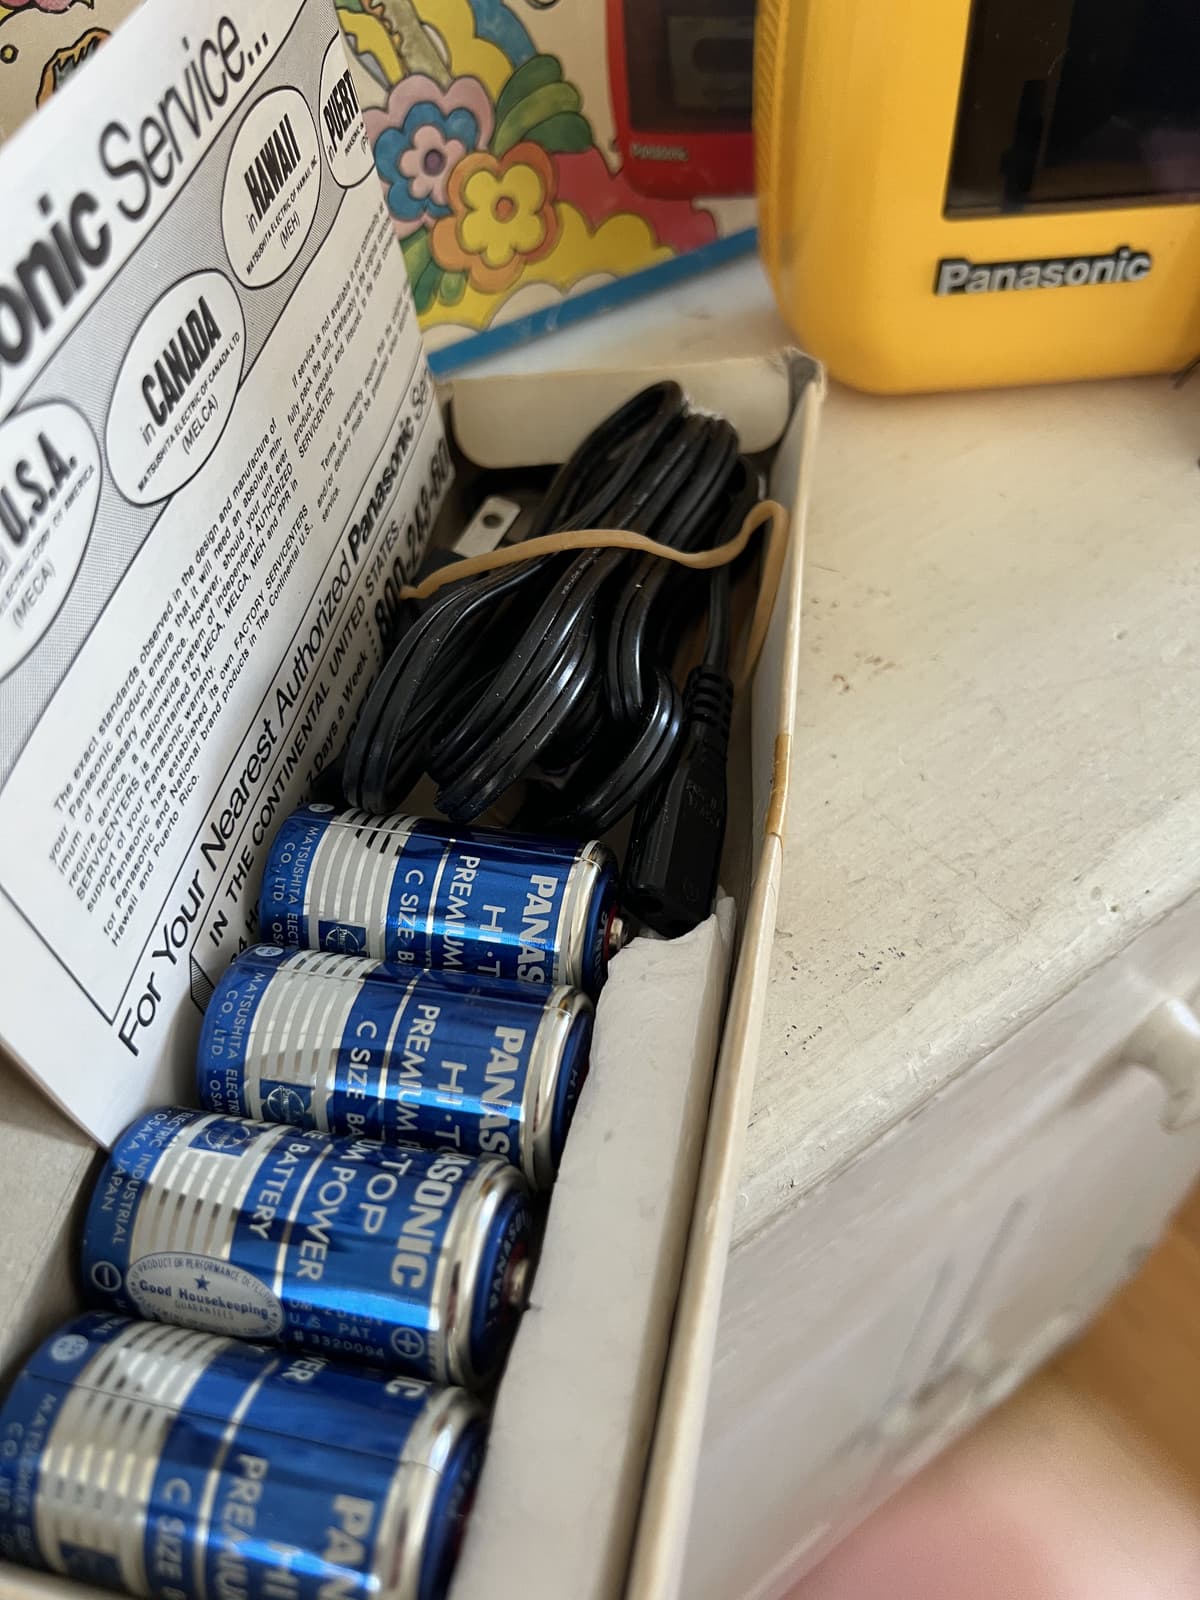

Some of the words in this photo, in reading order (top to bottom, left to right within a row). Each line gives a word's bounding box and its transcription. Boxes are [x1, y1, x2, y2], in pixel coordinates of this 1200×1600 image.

[99, 16, 268, 220] Service...
[244, 113, 301, 222] HAWAII
[246, 213, 258, 234] in
[280, 211, 300, 249] (MEH)
[934, 244, 1153, 297] Panasonic
[142, 296, 221, 426] CANADA
[140, 423, 155, 446] in
[182, 394, 218, 455] (MELCA)
[54, 784, 73, 810] The
[74, 736, 98, 779] exact
[99, 666, 139, 736] standards
[140, 601, 173, 664] observed
[172, 588, 182, 602] in
[182, 565, 194, 586] the
[196, 524, 218, 564] design
[219, 496, 232, 523] and
[233, 434, 269, 499] manufacture
[270, 418, 276, 434] of
[69, 742, 113, 818] Panasonic
[116, 680, 147, 738] product
[149, 632, 174, 677] ensure
[175, 600, 190, 627] that
[190, 586, 198, 599] it
[199, 560, 212, 584] will
[214, 526, 231, 559] need
[232, 510, 242, 526] an
[243, 462, 268, 508] absolute
[270, 438, 282, 460] min-
[85, 803, 94, 823] of
[96, 726, 137, 798] necessary
[140, 638, 186, 720] maintenance.
[189, 575, 219, 629] However,
[223, 528, 244, 570] should
[246, 500, 260, 530] your
[262, 474, 274, 498] unit
[276, 448, 288, 474] ever
[98, 774, 127, 826] service,
[132, 754, 138, 764] a
[140, 677, 180, 749] nationwide
[182, 628, 206, 673] system
[207, 608, 215, 625] of
[215, 536, 254, 607] independent
[256, 462, 292, 536] AUTHORIZED
[77, 777, 139, 900] SERVICENTERS
[140, 761, 149, 775] is
[151, 682, 190, 757] maintained
[190, 664, 201, 682] by
[201, 622, 223, 662] MECA,
[224, 573, 249, 618] MELCA,
[250, 538, 266, 570] MEH
[267, 515, 278, 540] and
[278, 490, 291, 517] PPR
[290, 479, 298, 492] in
[104, 913, 115, 935] for
[115, 833, 154, 908] Panasonic
[156, 800, 170, 829] and
[170, 742, 200, 798] National
[200, 701, 221, 740] brand
[222, 648, 249, 703] products
[249, 634, 257, 647] in
[257, 609, 269, 628] The
[269, 545, 300, 606] Continental
[110, 814, 150, 890] Panasonic
[150, 784, 166, 808] has
[169, 702, 208, 778] established
[208, 684, 218, 700] its
[220, 654, 234, 680] own
[234, 589, 264, 650] FACTORY
[266, 504, 308, 590] SERVICENTERS
[118, 972, 161, 1056] For
[152, 869, 205, 965] Your
[200, 718, 278, 872] Nearest
[276, 549, 351, 728] Authorized
[348, 417, 412, 565] Panasonic
[210, 910, 228, 948] IN
[226, 844, 256, 903] THE
[253, 682, 329, 846] CONTINENTAL
[329, 596, 364, 678] UNITED
[364, 521, 399, 596] STATES
[313, 721, 338, 773] Days
[342, 650, 368, 702] Week
[88, 852, 116, 912] support
[117, 830, 126, 849] of
[126, 796, 144, 832] your
[144, 724, 184, 793] Panasonic
[184, 666, 214, 720] warranty.
[112, 894, 138, 946] Hawaii
[140, 860, 154, 890] and
[154, 811, 178, 856] Puerto
[179, 776, 197, 806] Rico.
[286, 826, 319, 905] MATSUSHITA
[396, 892, 420, 939] SIZE
[403, 869, 424, 886] C
[441, 853, 481, 969] PREMIUM
[226, 971, 265, 1059] MATSUSHITA
[356, 1019, 378, 1039] C
[395, 1002, 440, 1132] PREMIUM
[344, 1046, 371, 1101] SIZE
[101, 1158, 126, 1211] JAPAN
[112, 1153, 152, 1245] INDUSTRIAL
[249, 1142, 310, 1239] BATTERY
[296, 1166, 354, 1281] POWER
[137, 1278, 174, 1297] Good
[176, 1287, 271, 1321] Housekeeping
